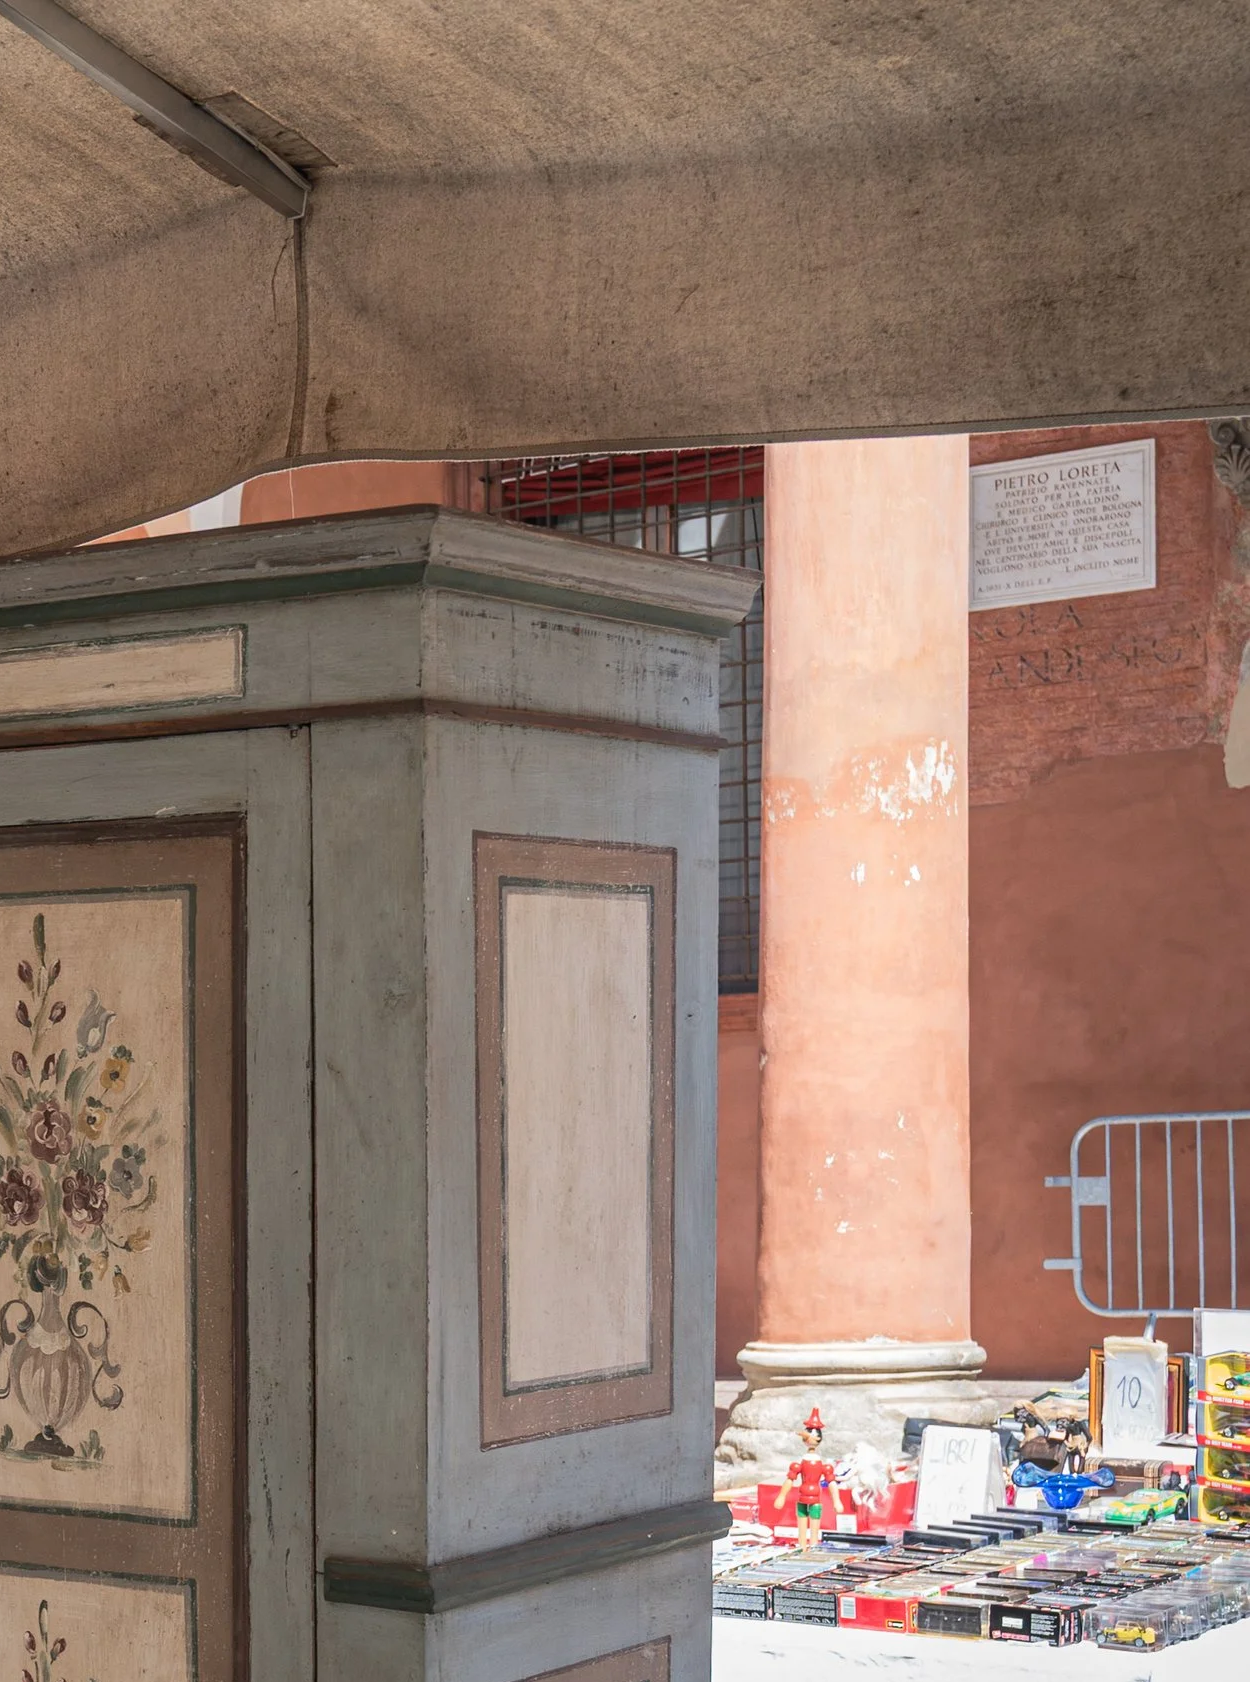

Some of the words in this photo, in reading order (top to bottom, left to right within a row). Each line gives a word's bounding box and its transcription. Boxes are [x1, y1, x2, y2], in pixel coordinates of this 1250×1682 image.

[994, 472, 1049, 491] PIETRO
[1059, 461, 1121, 481] LORETA
[995, 497, 1038, 509] SOLDATO
[1044, 493, 1062, 502] PER
[1068, 490, 1080, 498] LA
[1086, 485, 1121, 495] PATRIA
[1006, 486, 1047, 498] PATRIZIO
[1054, 477, 1110, 491] RAVENNATE
[1008, 504, 1046, 516] MEDICO
[1052, 493, 1119, 510] GARIBALDINO
[1032, 511, 1068, 521] CLINICO
[1073, 507, 1097, 516] ONDE
[1102, 500, 1142, 512] BOLOGNA
[1107, 521, 1130, 530] CASA
[1043, 538, 1069, 548] AMICI
[1052, 547, 1078, 556] DELLA
[1102, 538, 1142, 549] NASCITA
[1113, 556, 1139, 566] NOME
[1116, 1375, 1142, 1409] 10
